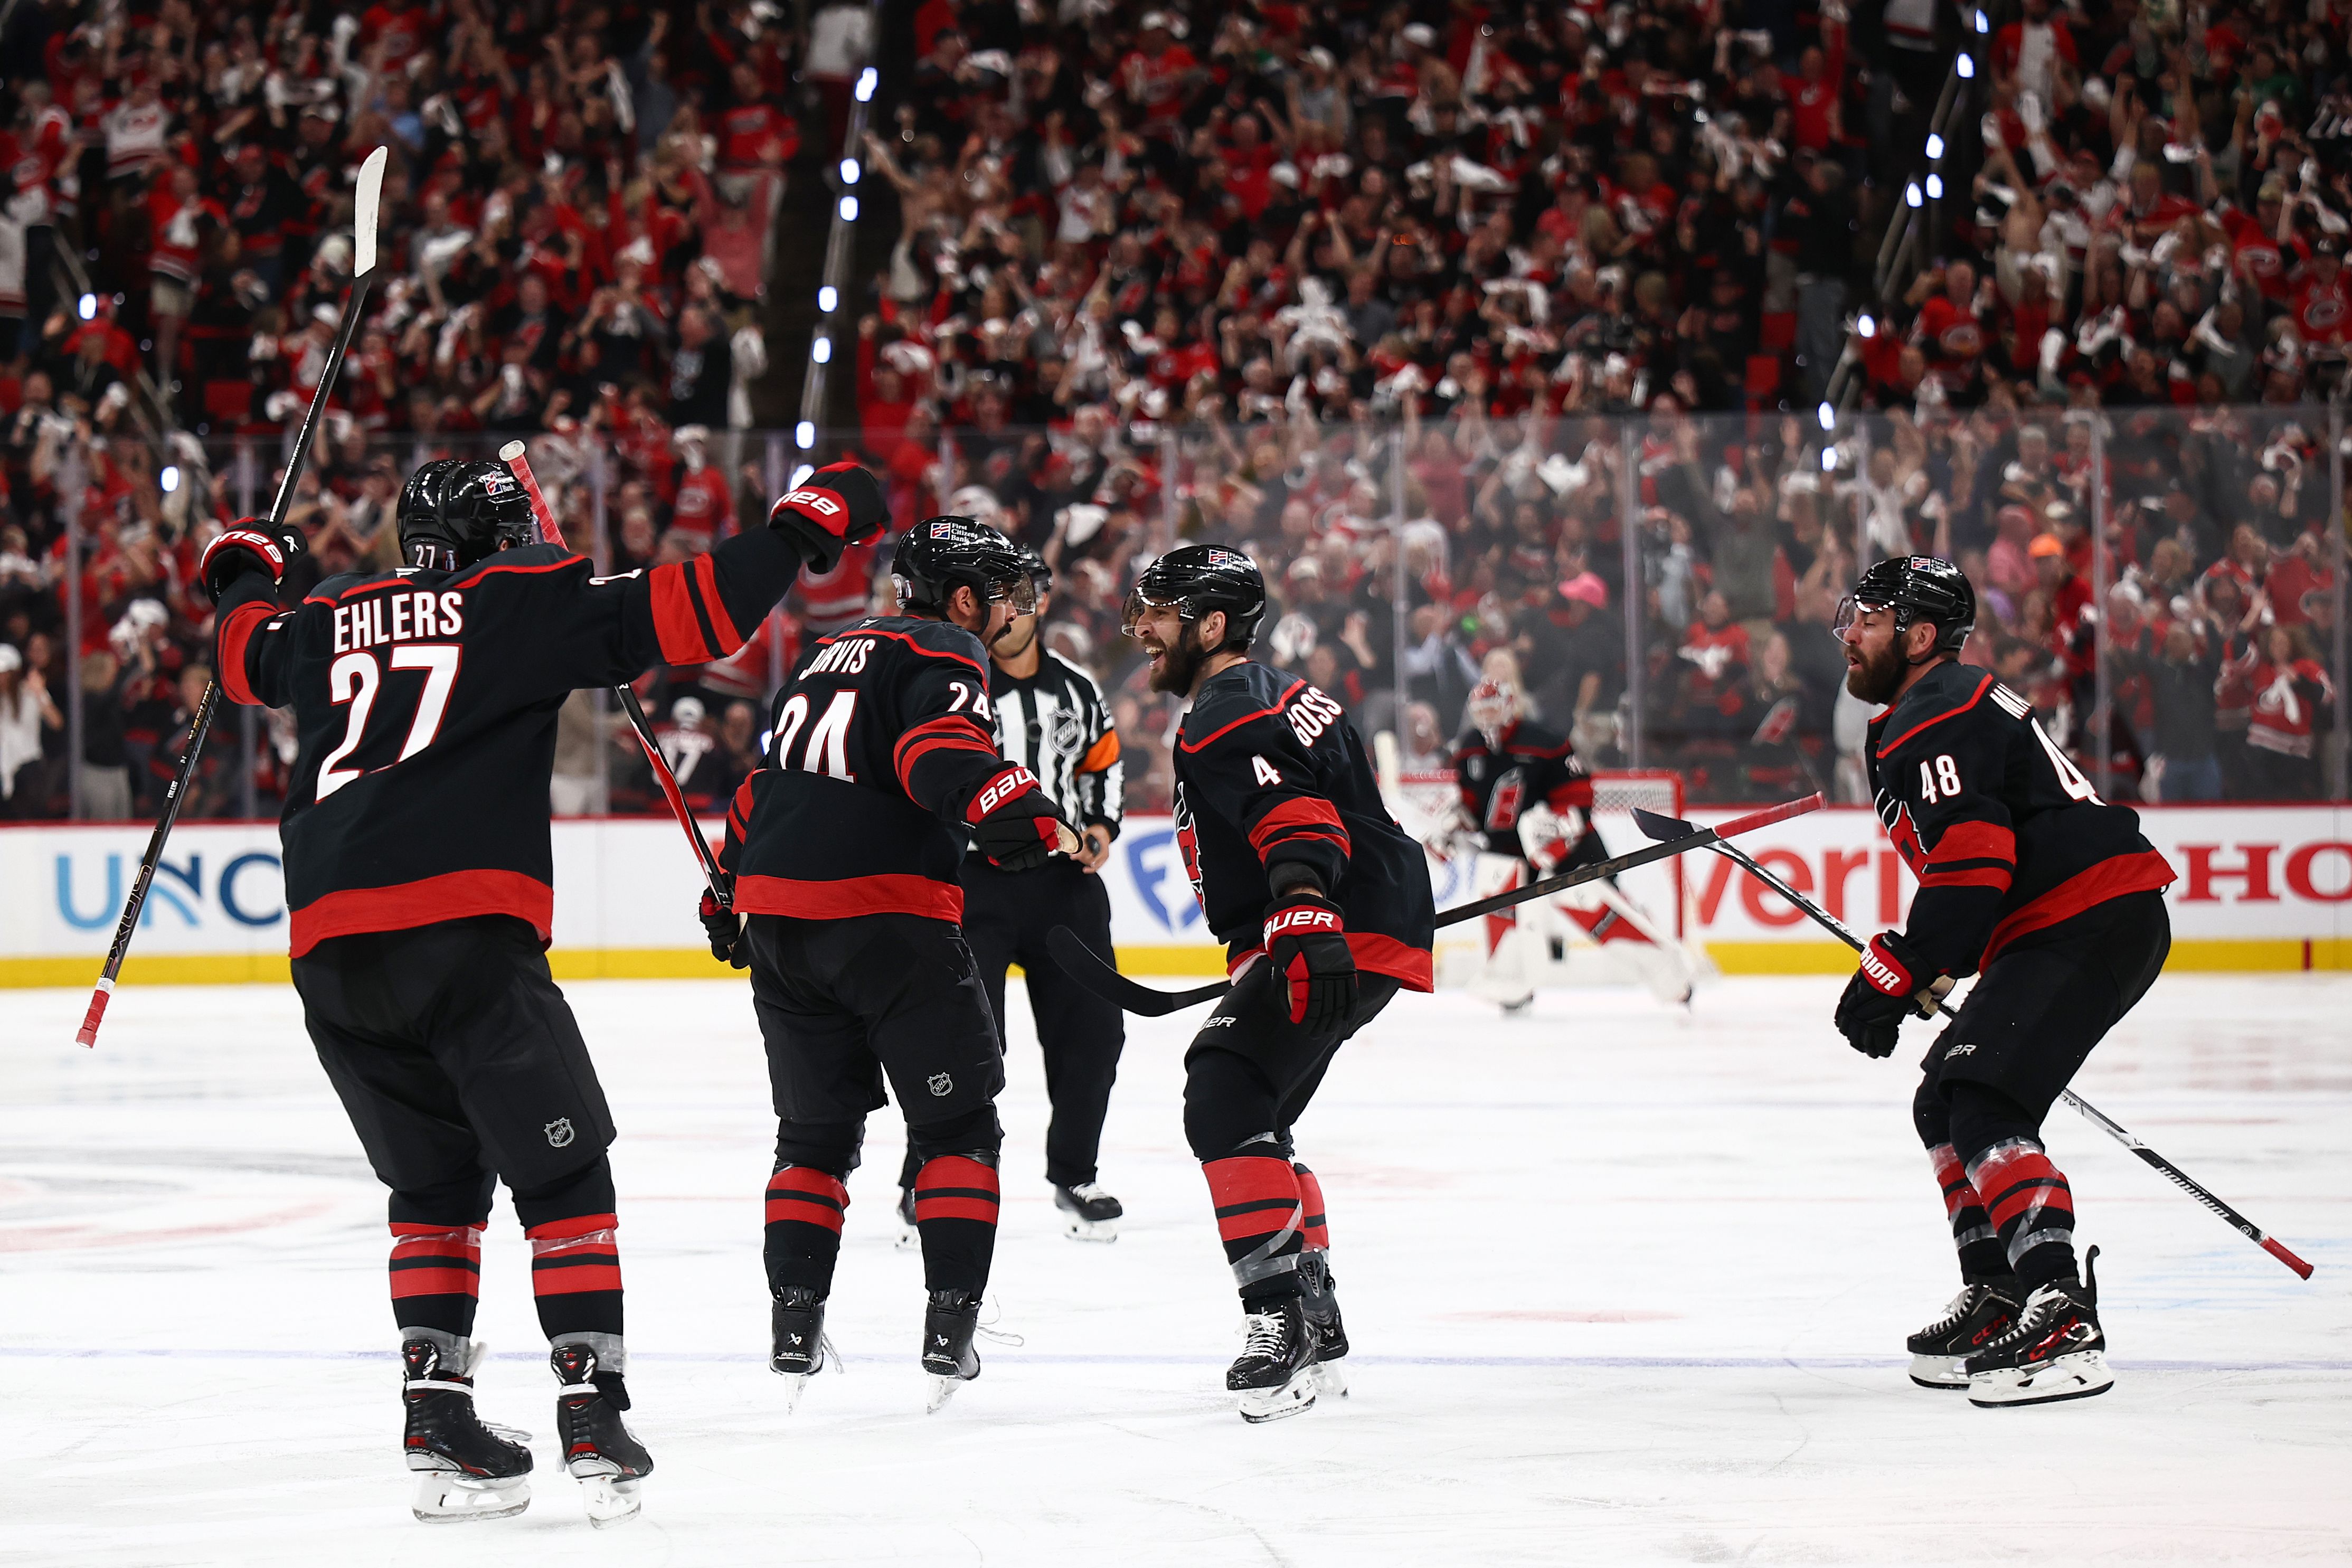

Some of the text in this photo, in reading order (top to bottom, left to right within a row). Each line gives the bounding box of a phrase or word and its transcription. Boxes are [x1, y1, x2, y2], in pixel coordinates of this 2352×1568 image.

[415, 544, 436, 569] 27
[951, 534, 970, 544] Bank
[333, 590, 465, 655] EHLERS
[316, 643, 464, 802] 27
[947, 681, 992, 722] 24
[773, 688, 860, 783] 24
[1251, 753, 1283, 787] 4
[1919, 754, 1962, 805] 48
[2030, 716, 2108, 807] 4
[55, 852, 284, 930] UNC
[1536, 856, 1629, 895] CCM
[2175, 840, 2352, 903] HO
[1263, 910, 1334, 951] AUER
[2156, 1166, 2230, 1218] WARRIOR
